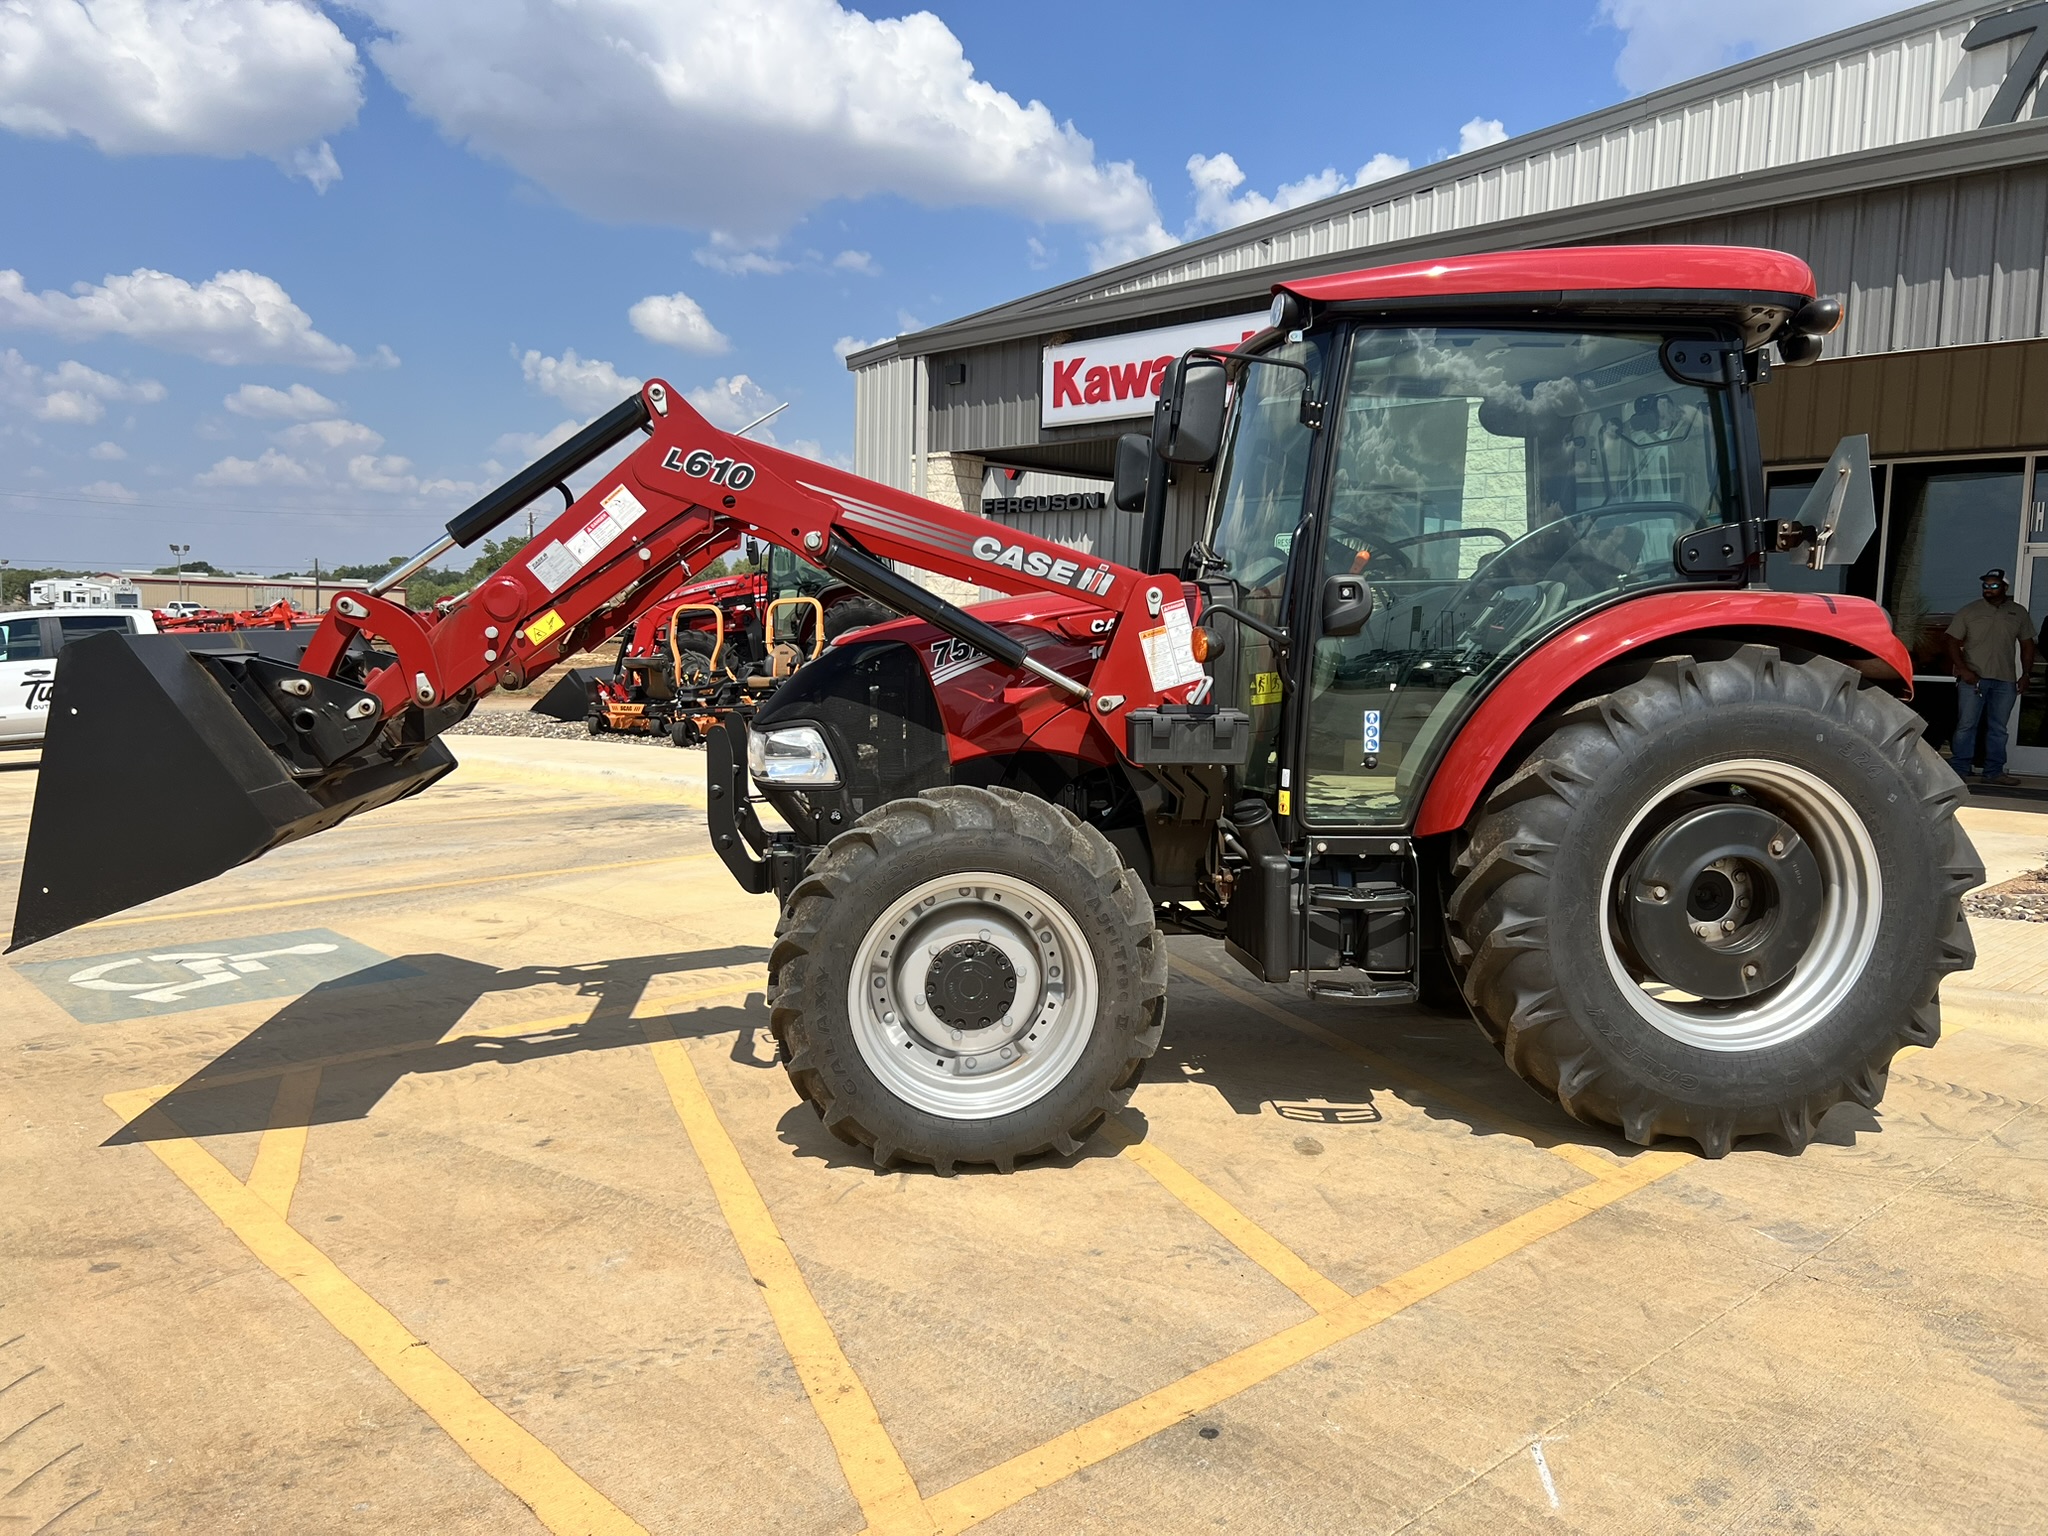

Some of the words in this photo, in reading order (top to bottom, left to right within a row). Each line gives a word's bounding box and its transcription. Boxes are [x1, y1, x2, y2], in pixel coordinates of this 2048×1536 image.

[661, 446, 756, 491] L610
[981, 492, 1105, 515] FERGUSON
[972, 536, 1079, 586] CASE
[815, 965, 858, 1096] GALAXY
